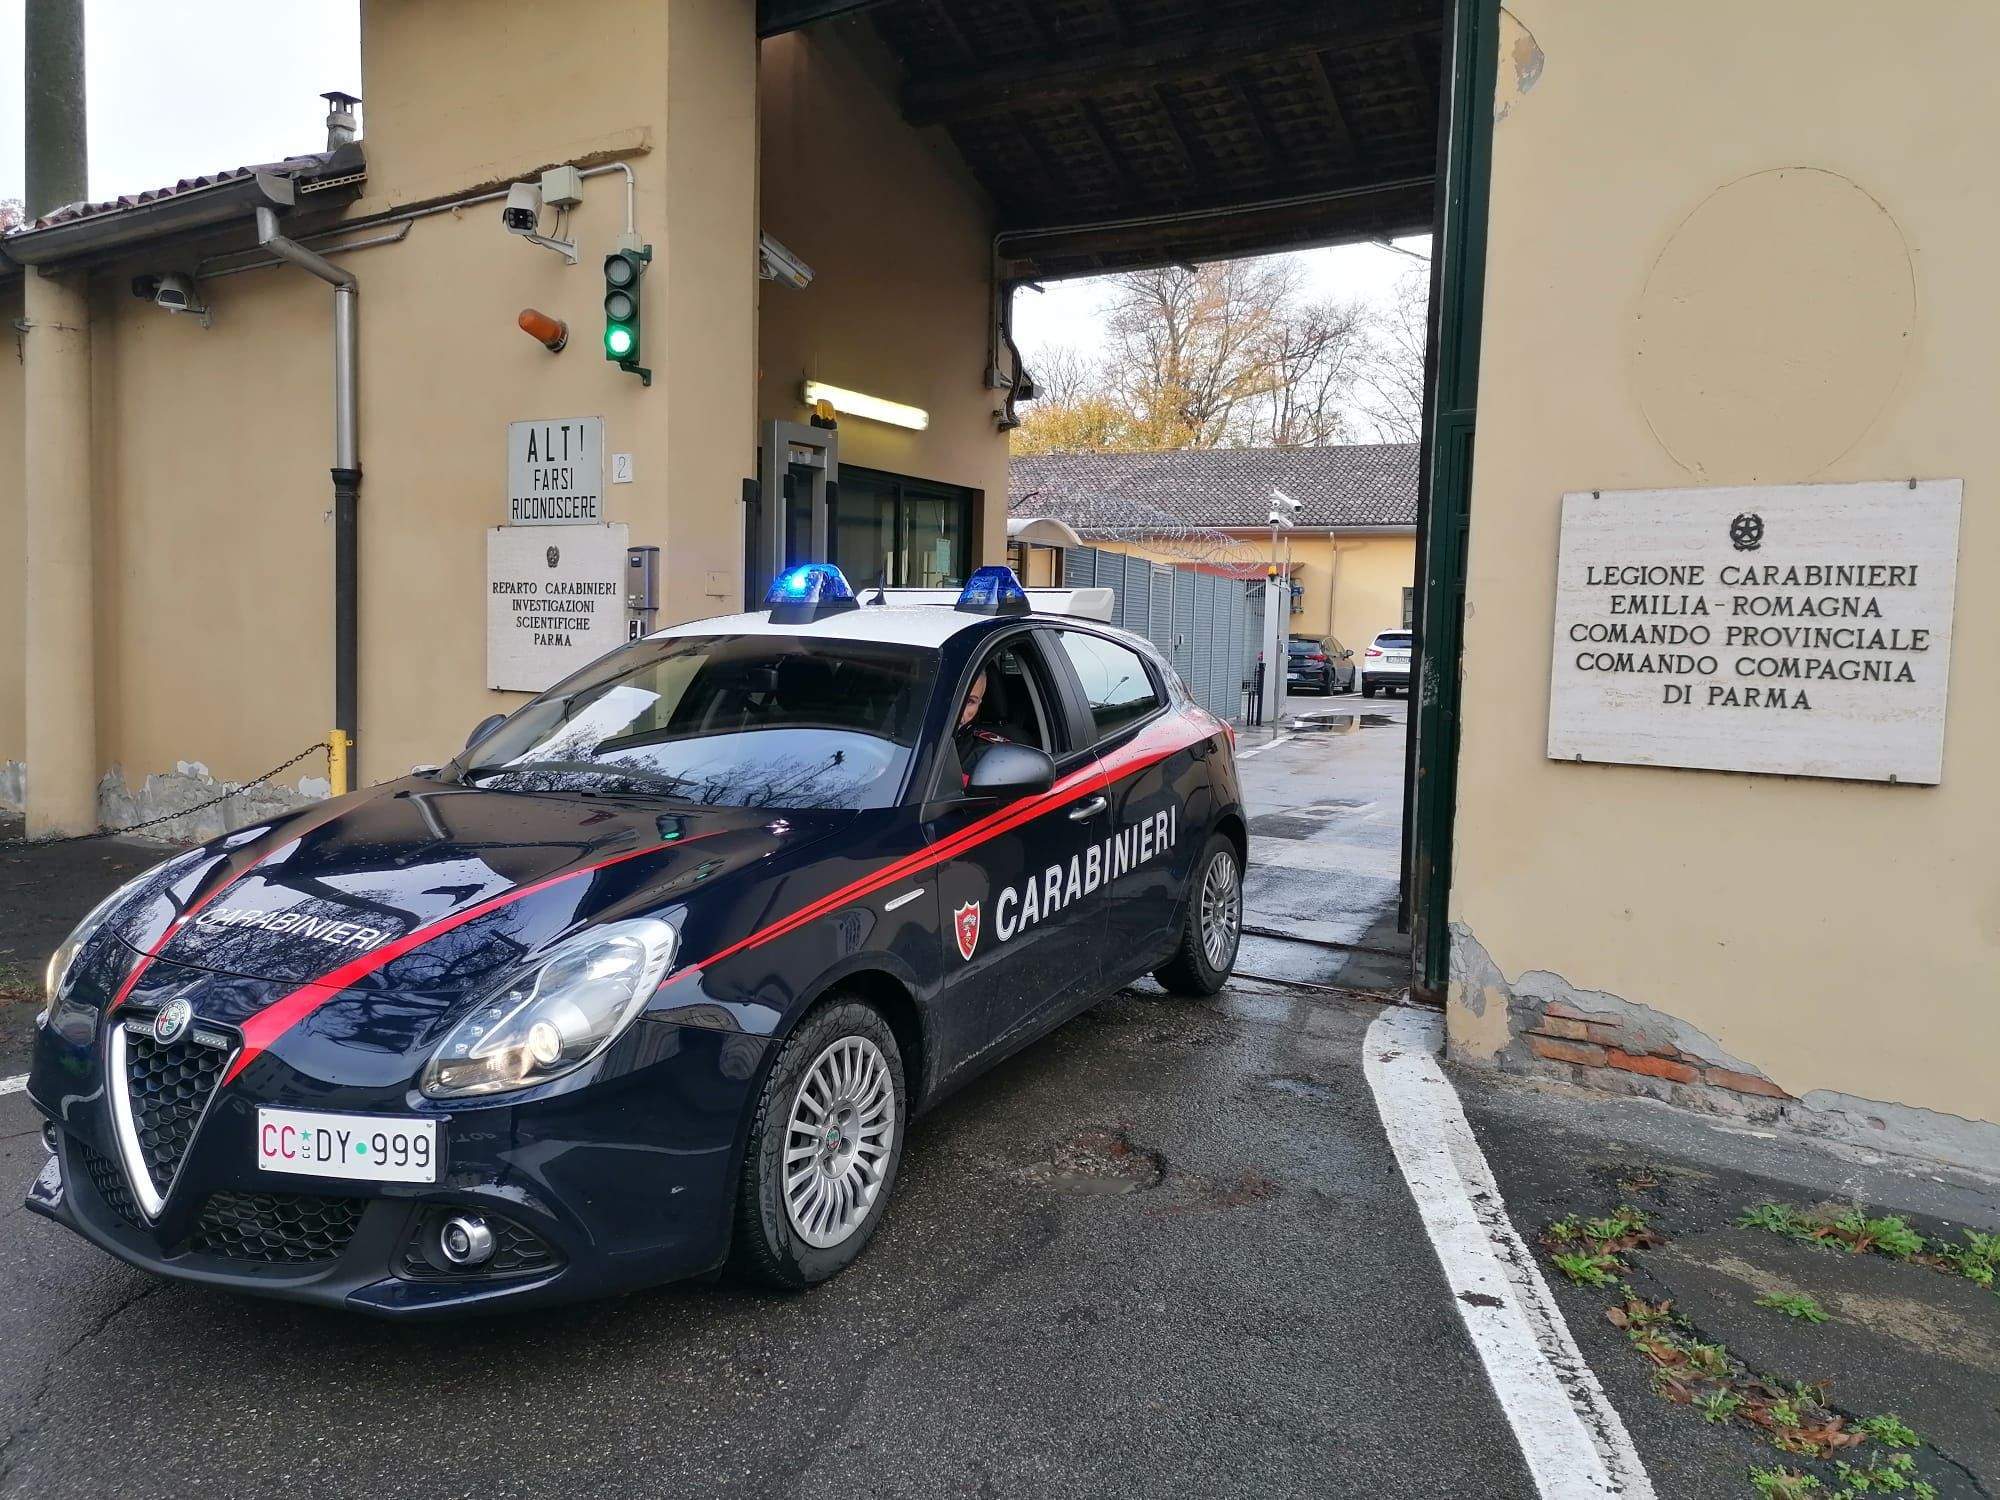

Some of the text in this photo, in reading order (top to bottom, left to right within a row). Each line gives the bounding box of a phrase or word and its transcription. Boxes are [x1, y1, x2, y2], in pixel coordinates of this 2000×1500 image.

[527, 424, 584, 463] ALT!
[534, 467, 574, 491] FARSI
[617, 455, 627, 479] 2
[512, 495, 597, 520] RICONOSCERE
[1587, 564, 1919, 587] LEGIONE CARABINIERI
[492, 582, 617, 596] REPARTO CARABINIERI
[512, 599, 595, 613] INVESTIGAZIONI
[516, 616, 591, 631] SCIENTIFICHE
[534, 633, 572, 647] PARMA
[1569, 623, 1931, 652] COMANDO PROVINCIALE
[1576, 652, 1917, 683] COMANDO COMPAGNIA
[1662, 685, 1813, 711] DI PARMA
[995, 804, 1176, 943] CARABINIERI
[196, 908, 392, 951] CARABINIERI
[372, 1133, 430, 1168] 999
